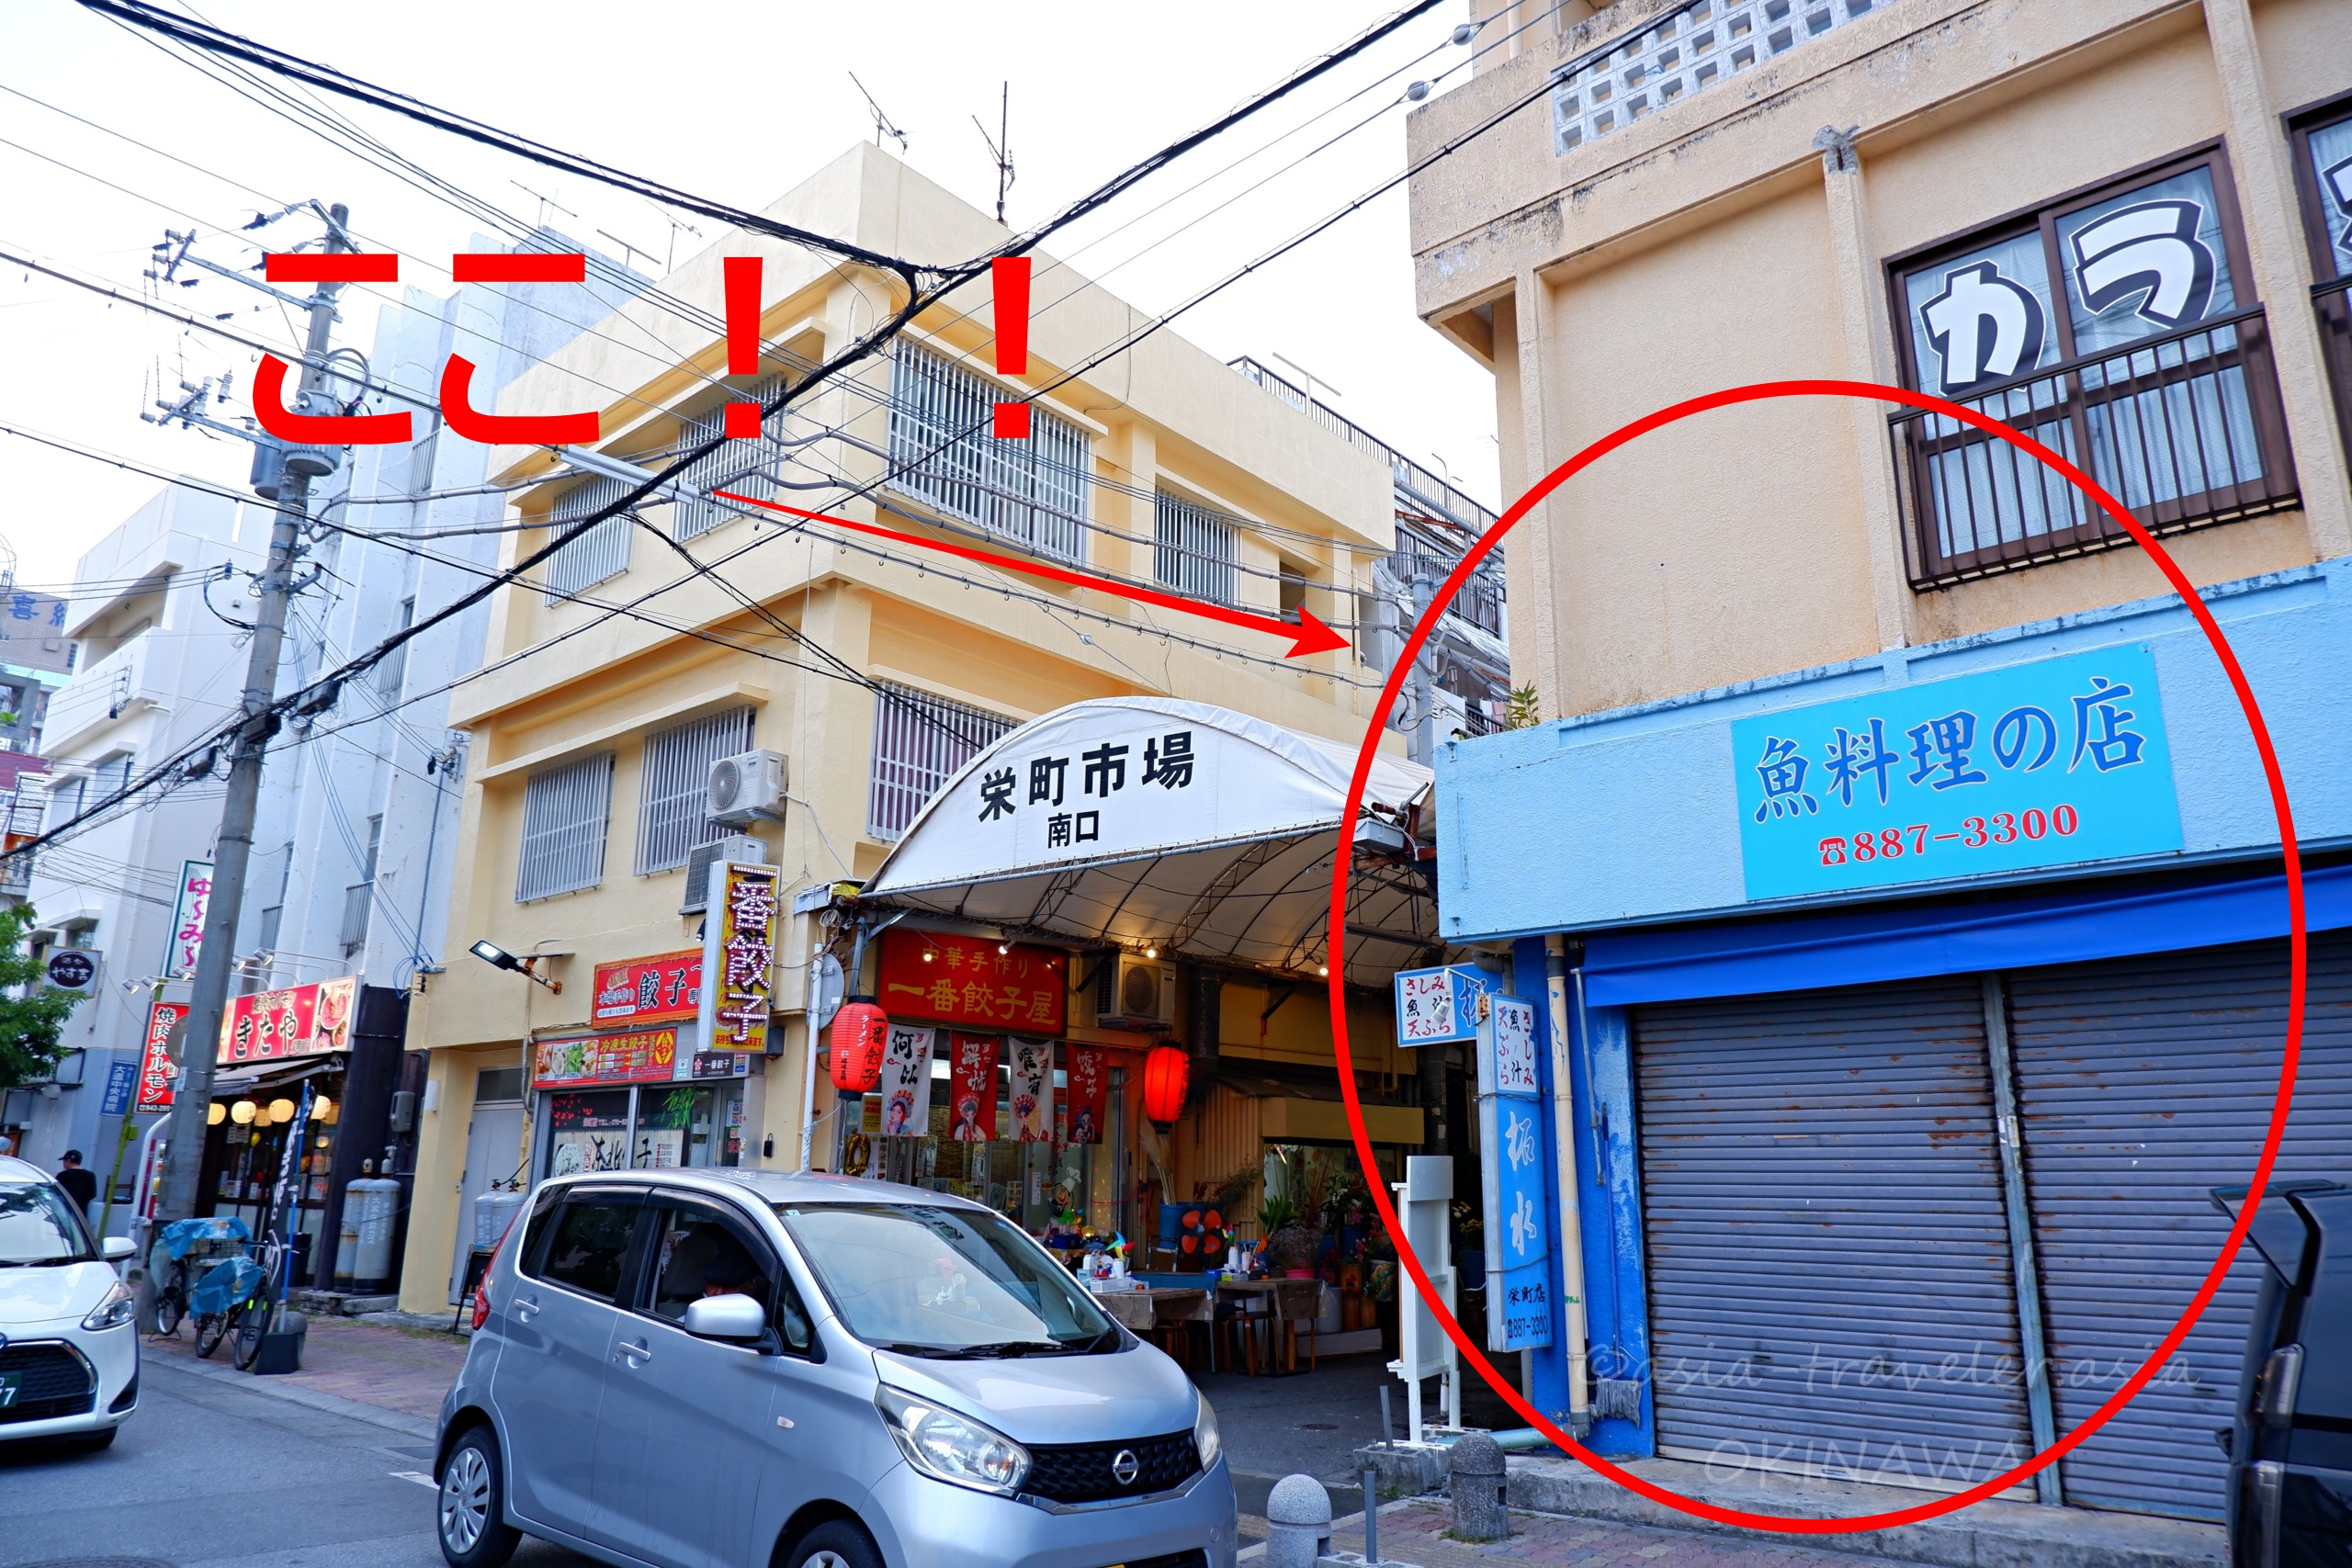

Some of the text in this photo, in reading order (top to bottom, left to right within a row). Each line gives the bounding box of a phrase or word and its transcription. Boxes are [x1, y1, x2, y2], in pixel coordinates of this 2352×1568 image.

[1753, 675, 2147, 824] 魚料理の店
[978, 731, 1196, 823] 栄町市場
[1047, 809, 1100, 849] 南口
[1852, 804, 2080, 862] 887-3300
[51, 966, 90, 981] やす吉
[718, 864, 778, 1043] 一番餃子
[922, 943, 1029, 979] 中華手作り
[638, 967, 687, 1010] 餃子
[888, 977, 1057, 1025] 一番餃子屋
[1405, 975, 1445, 997] さしみ
[234, 1010, 299, 1057] きたや
[857, 1014, 870, 1046] ラーメン
[1497, 1005, 1510, 1085] 天ぷら
[1509, 1009, 1522, 1083] 魚汁
[1522, 1010, 1534, 1086] さしみ
[142, 1007, 177, 1104] 焼肉ホルモン
[704, 1058, 730, 1070] 一番餃子
[104, 1065, 127, 1112] 大道中央病院
[1508, 1282, 1546, 1307] 栄町店
[0, 1386, 17, 1406] 7
